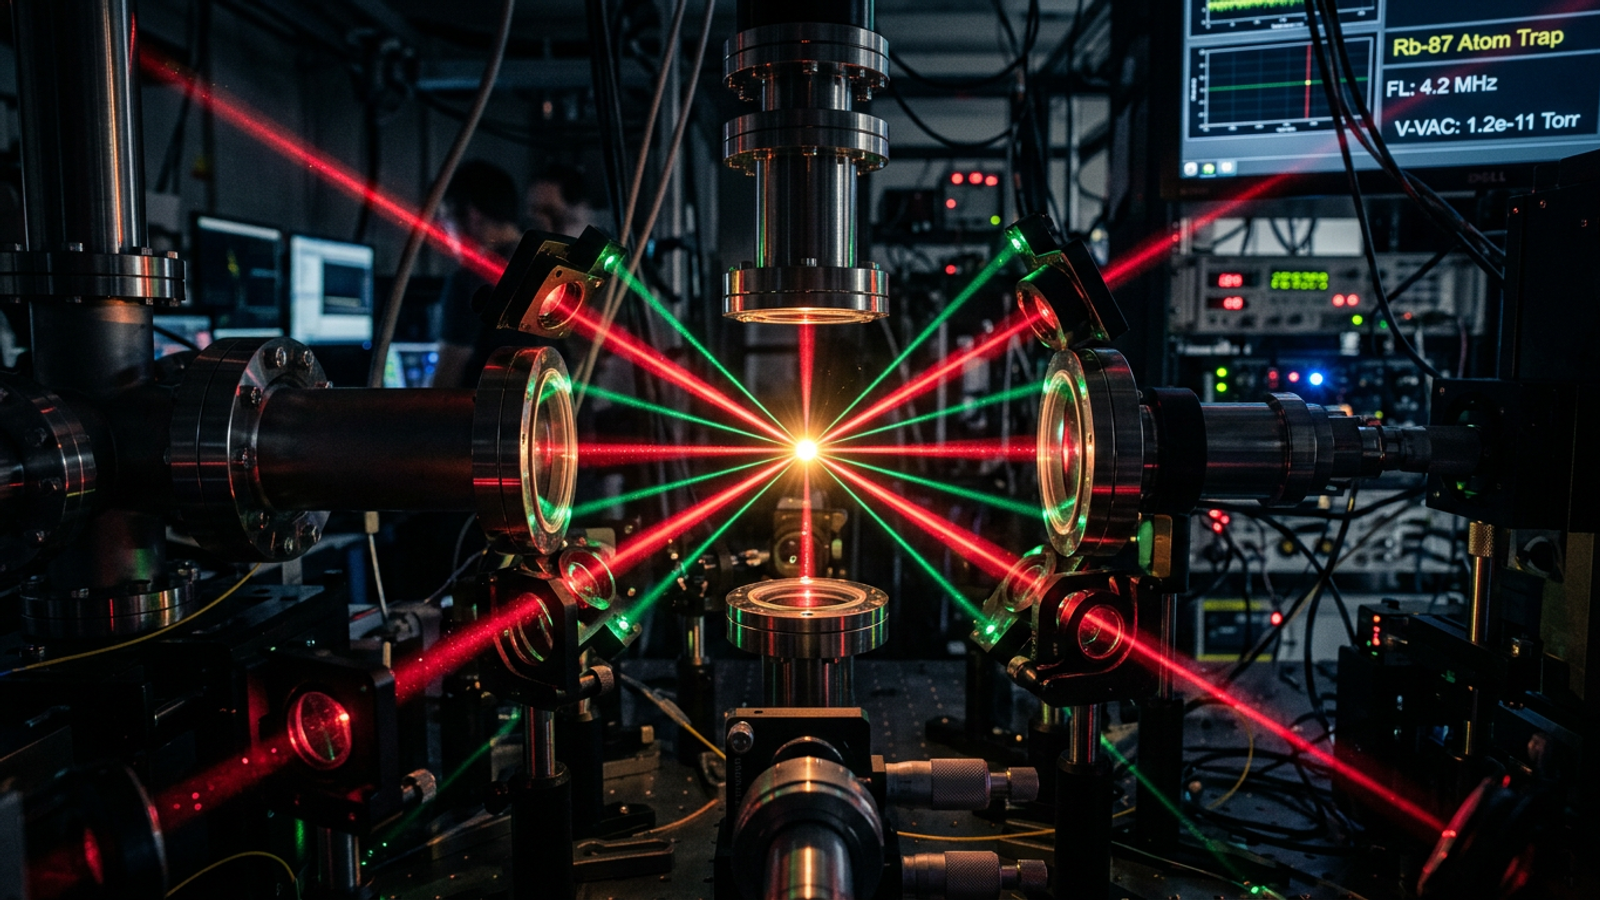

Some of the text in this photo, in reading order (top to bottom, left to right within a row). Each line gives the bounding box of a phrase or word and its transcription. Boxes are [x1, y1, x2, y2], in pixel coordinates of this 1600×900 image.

[1393, 28, 1564, 56] Rb-87 Atom Trap
[1386, 75, 1498, 97] FL: 4.2 MHz
[1395, 112, 1581, 137] V-VAC: 1.2e-11 Torr
[1468, 171, 1506, 183] DELL
